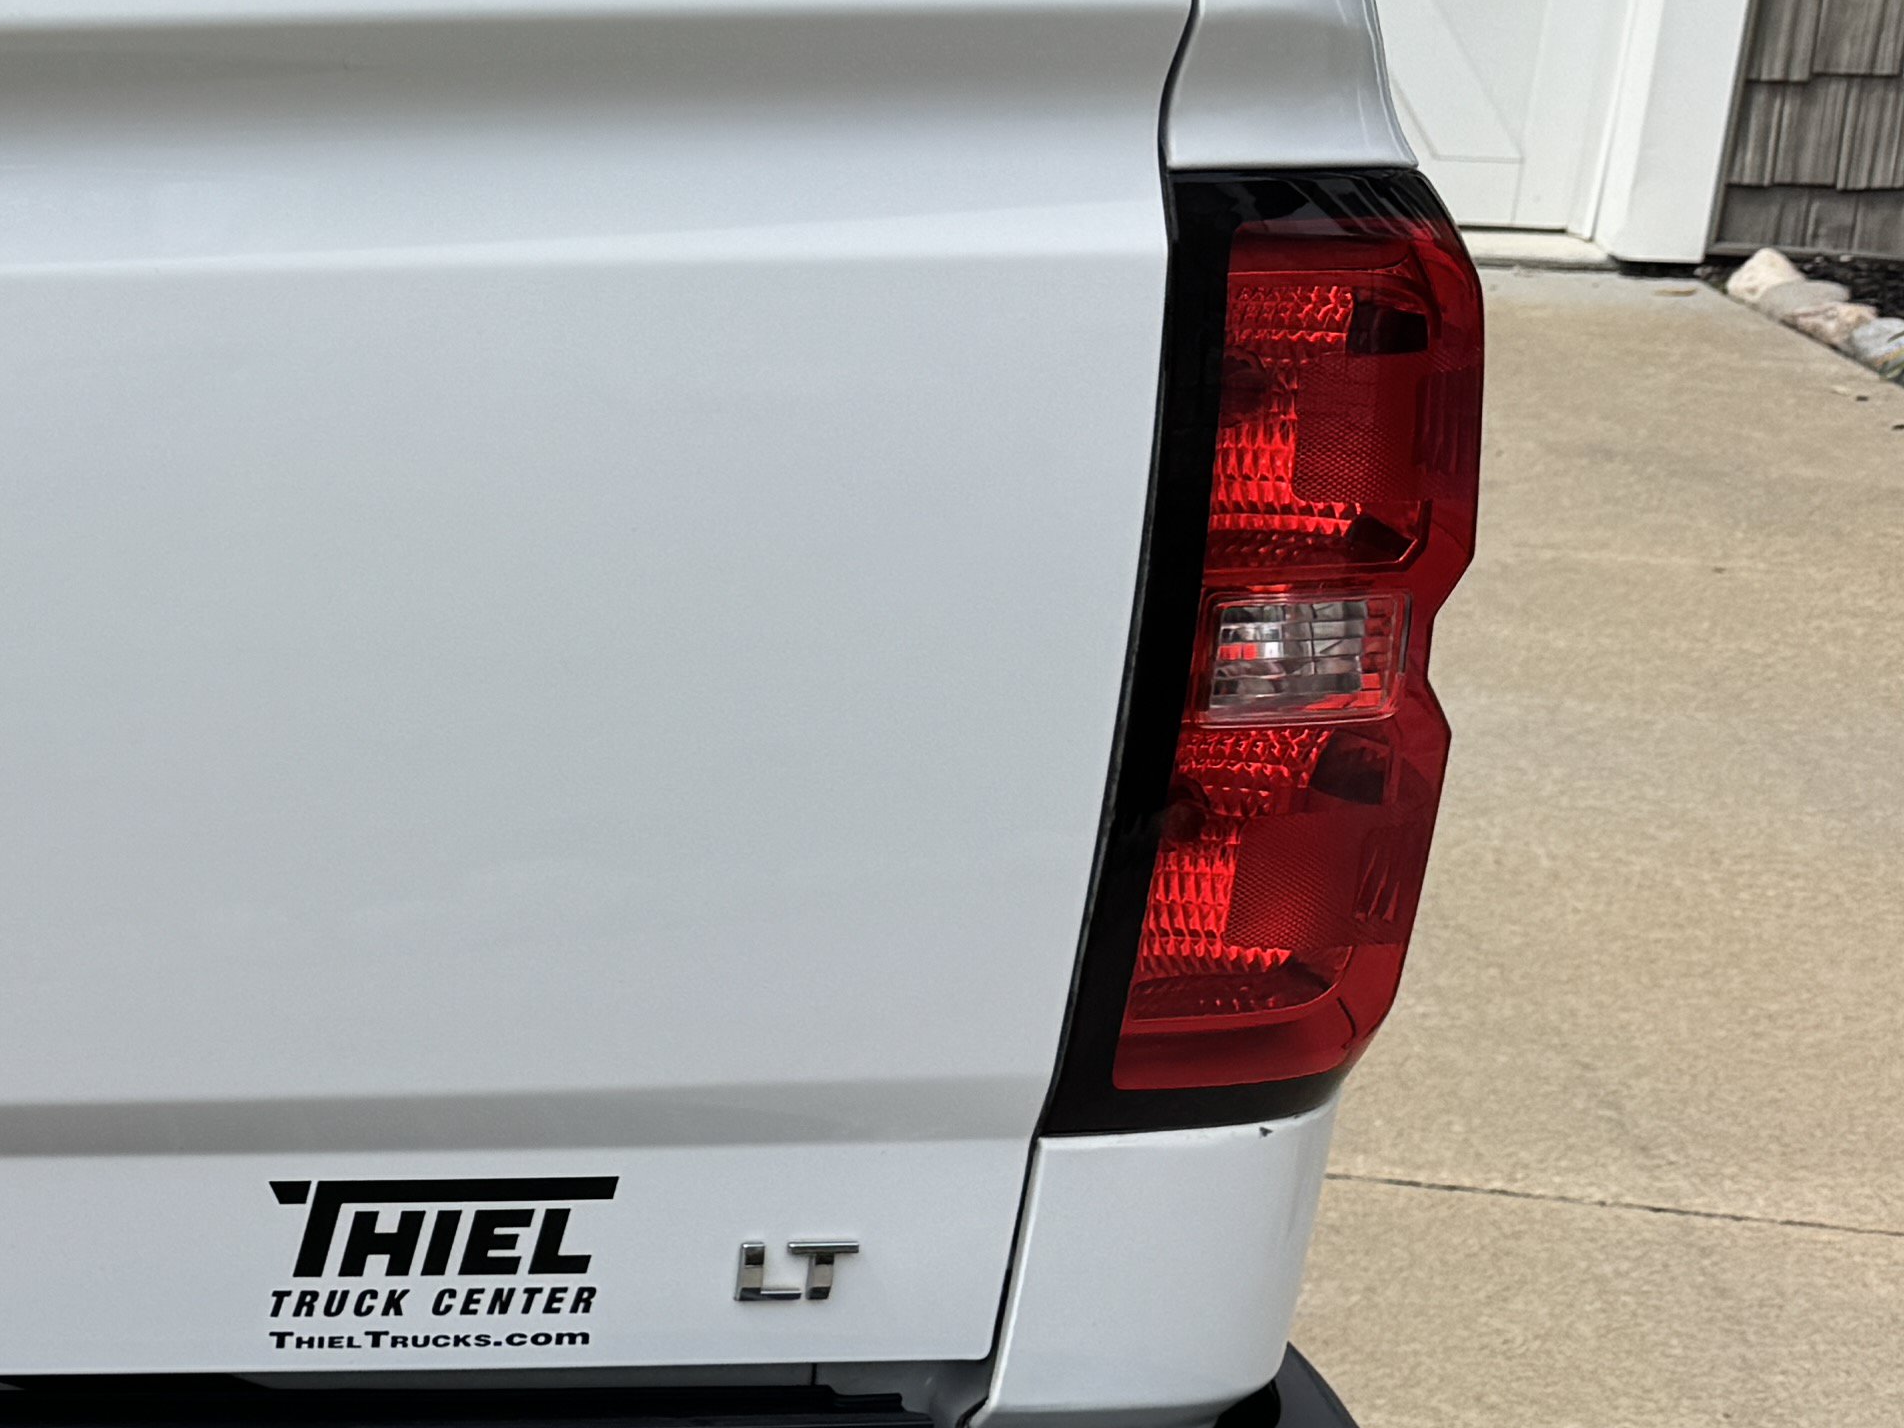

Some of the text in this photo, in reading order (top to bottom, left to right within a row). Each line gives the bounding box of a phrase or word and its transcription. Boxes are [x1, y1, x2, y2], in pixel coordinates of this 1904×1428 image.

[268, 1175, 620, 1278] THIEL
[269, 1286, 597, 1318] TRUCK CENTER
[733, 1240, 861, 1302] LT
